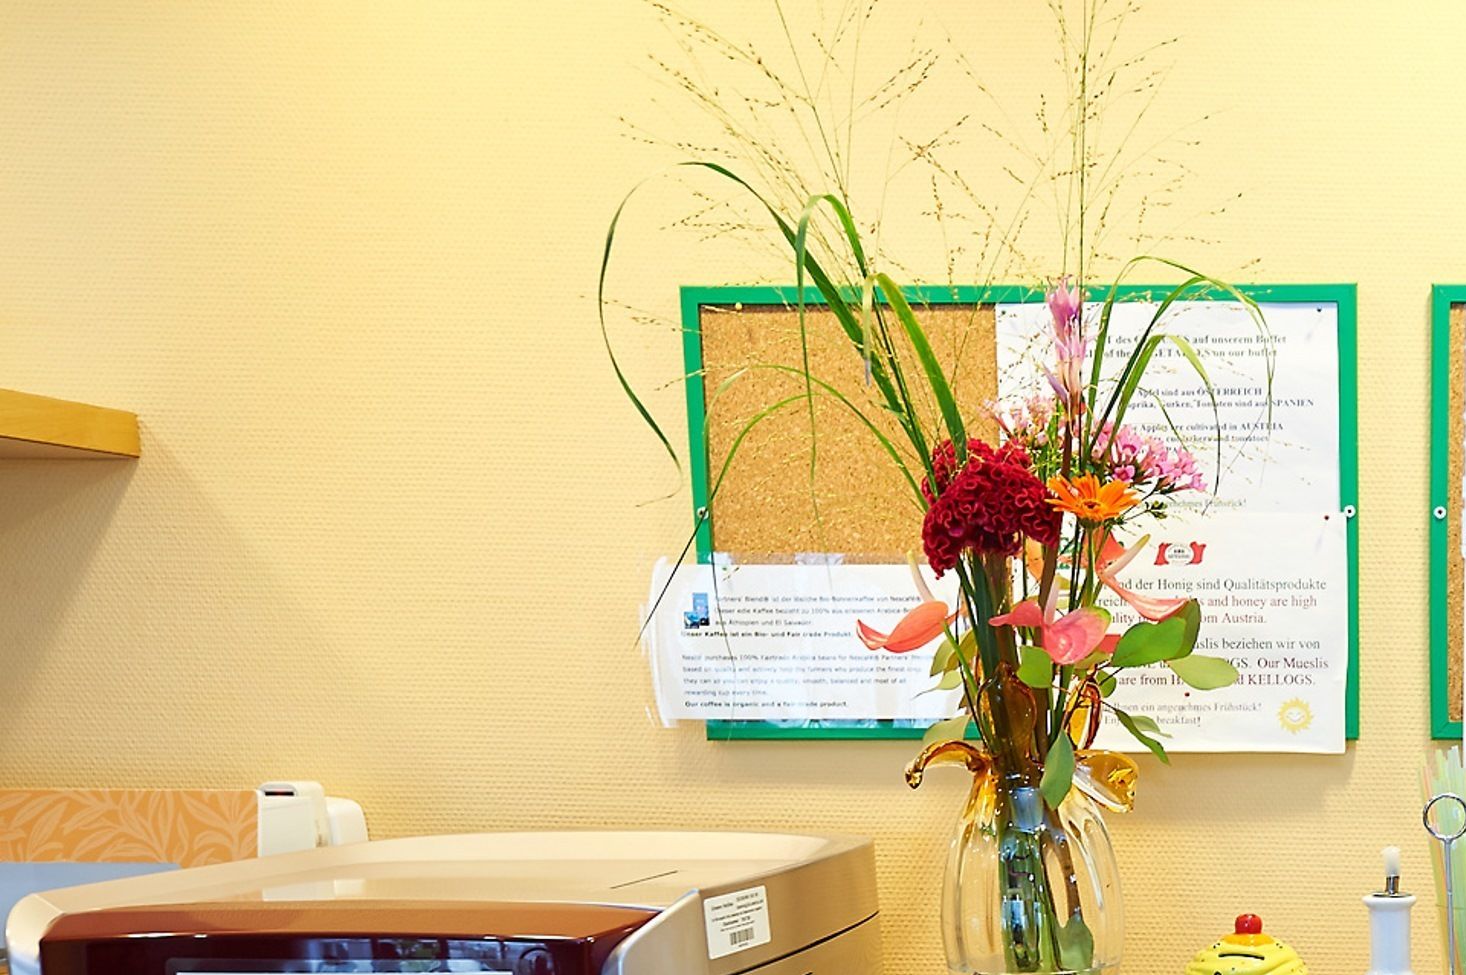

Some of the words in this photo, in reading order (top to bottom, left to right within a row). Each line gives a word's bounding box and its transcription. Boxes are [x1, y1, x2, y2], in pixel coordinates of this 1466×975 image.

[1136, 578, 1153, 590] der
[1157, 578, 1193, 594] Honig
[1196, 578, 1221, 590] sind
[1224, 578, 1327, 594] Qualitätsprodukte
[1207, 595, 1228, 607] and
[1231, 595, 1265, 611] honey
[1269, 598, 1288, 607] are
[1291, 595, 1317, 611] high
[1222, 613, 1267, 624] Austria.
[1222, 637, 1272, 650] beziehen
[1275, 638, 1295, 650] wir
[1298, 640, 1320, 650] von
[1257, 657, 1279, 669] Our
[1283, 656, 1329, 670] Mueslis
[1119, 676, 1137, 686] are
[1140, 674, 1167, 686] from
[1248, 674, 1316, 686] KELLOGS.
[1141, 703, 1154, 712] ein
[1157, 703, 1211, 714] angenehmes
